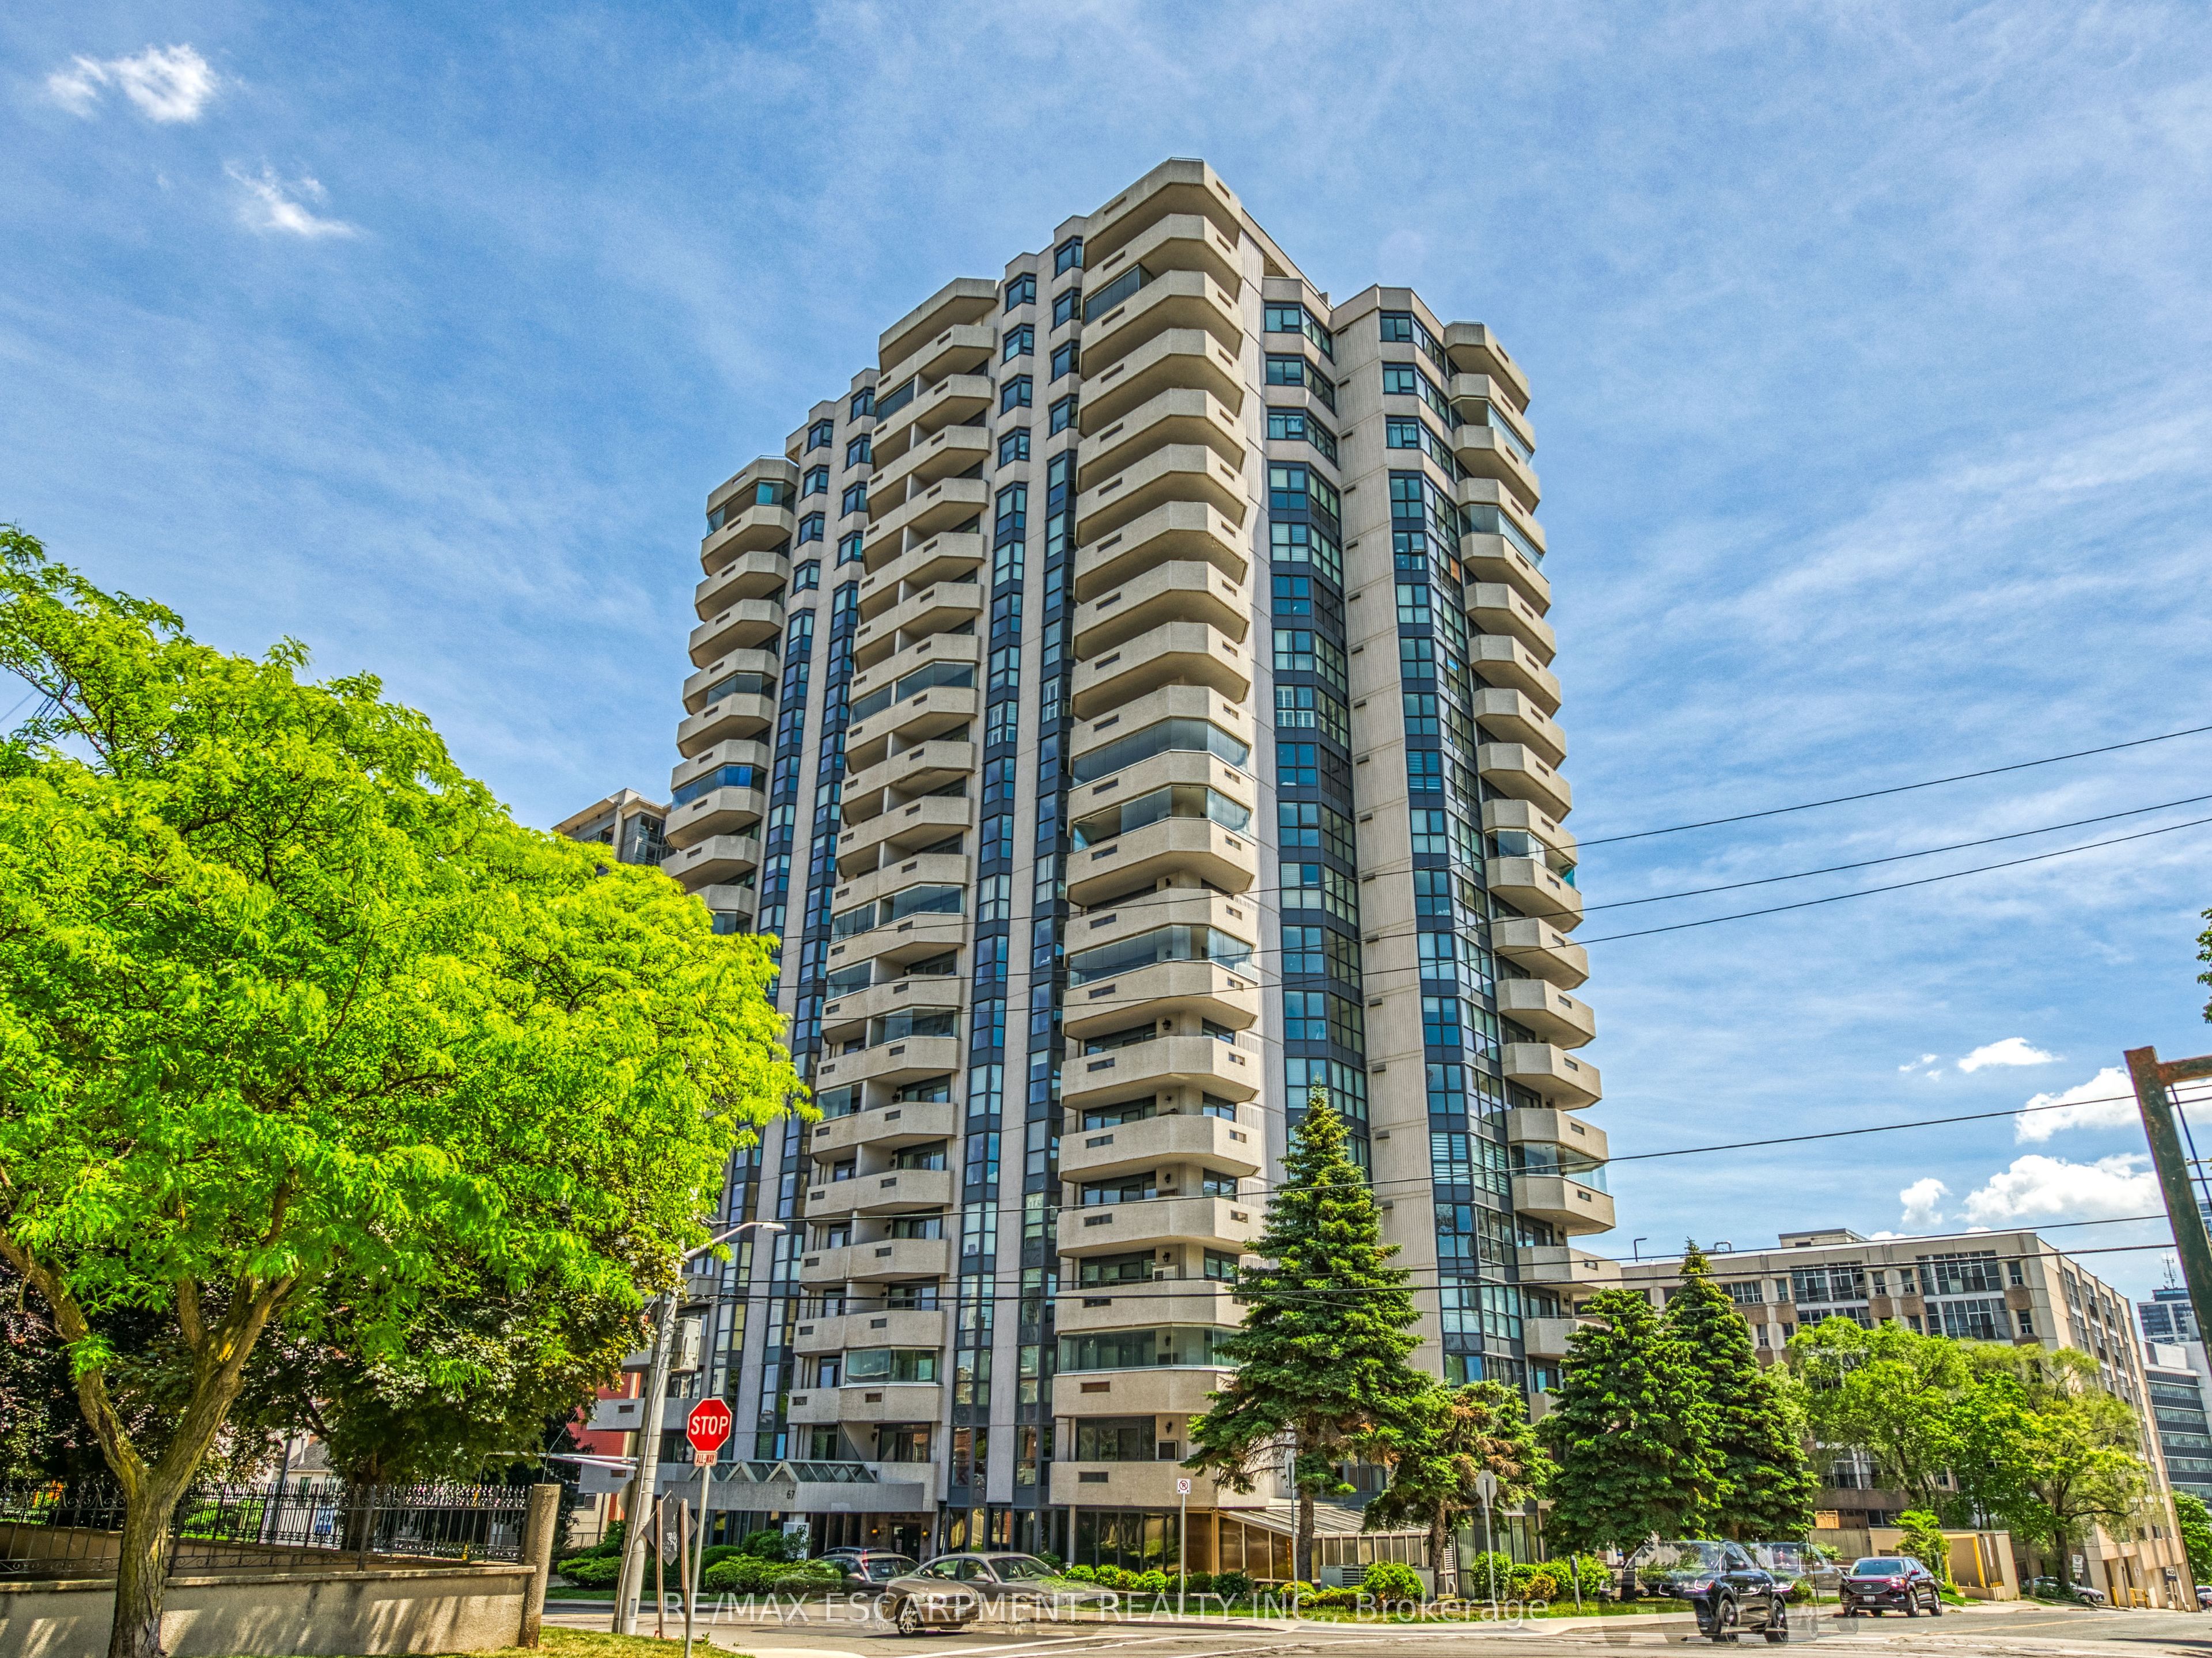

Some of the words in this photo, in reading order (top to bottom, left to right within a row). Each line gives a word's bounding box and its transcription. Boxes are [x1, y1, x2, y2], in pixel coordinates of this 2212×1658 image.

[691, 1416, 729, 1435] STOP
[696, 1454, 715, 1464] ALL-WAY
[787, 1490, 795, 1500] 67
[320, 1514, 331, 1522] 40
